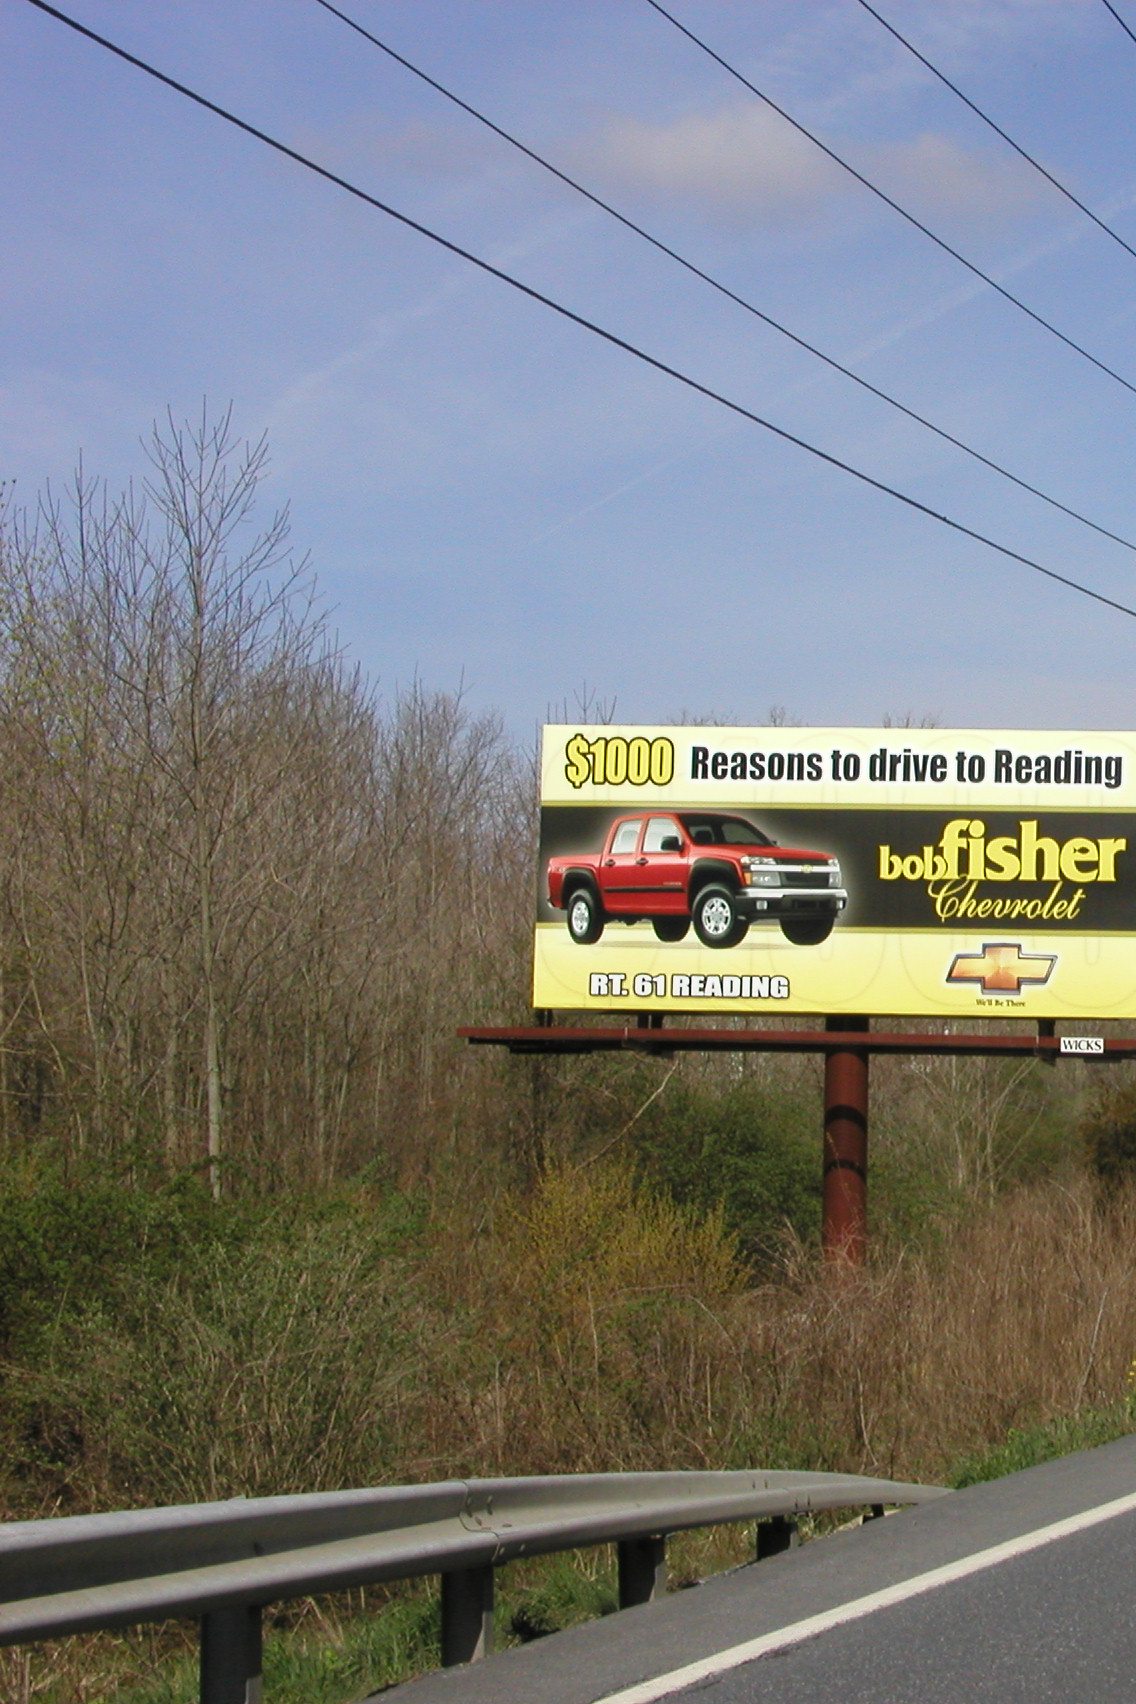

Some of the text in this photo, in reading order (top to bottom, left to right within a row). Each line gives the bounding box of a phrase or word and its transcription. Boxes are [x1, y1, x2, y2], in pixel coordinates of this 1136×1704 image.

[565, 733, 1123, 789] $1000 Reasons to drive to Reading
[879, 818, 1127, 882] bob fisher
[927, 874, 1086, 923] Chevrolet
[589, 973, 790, 999] RT. 61 READING
[1062, 1039, 1102, 1051] WICKS
